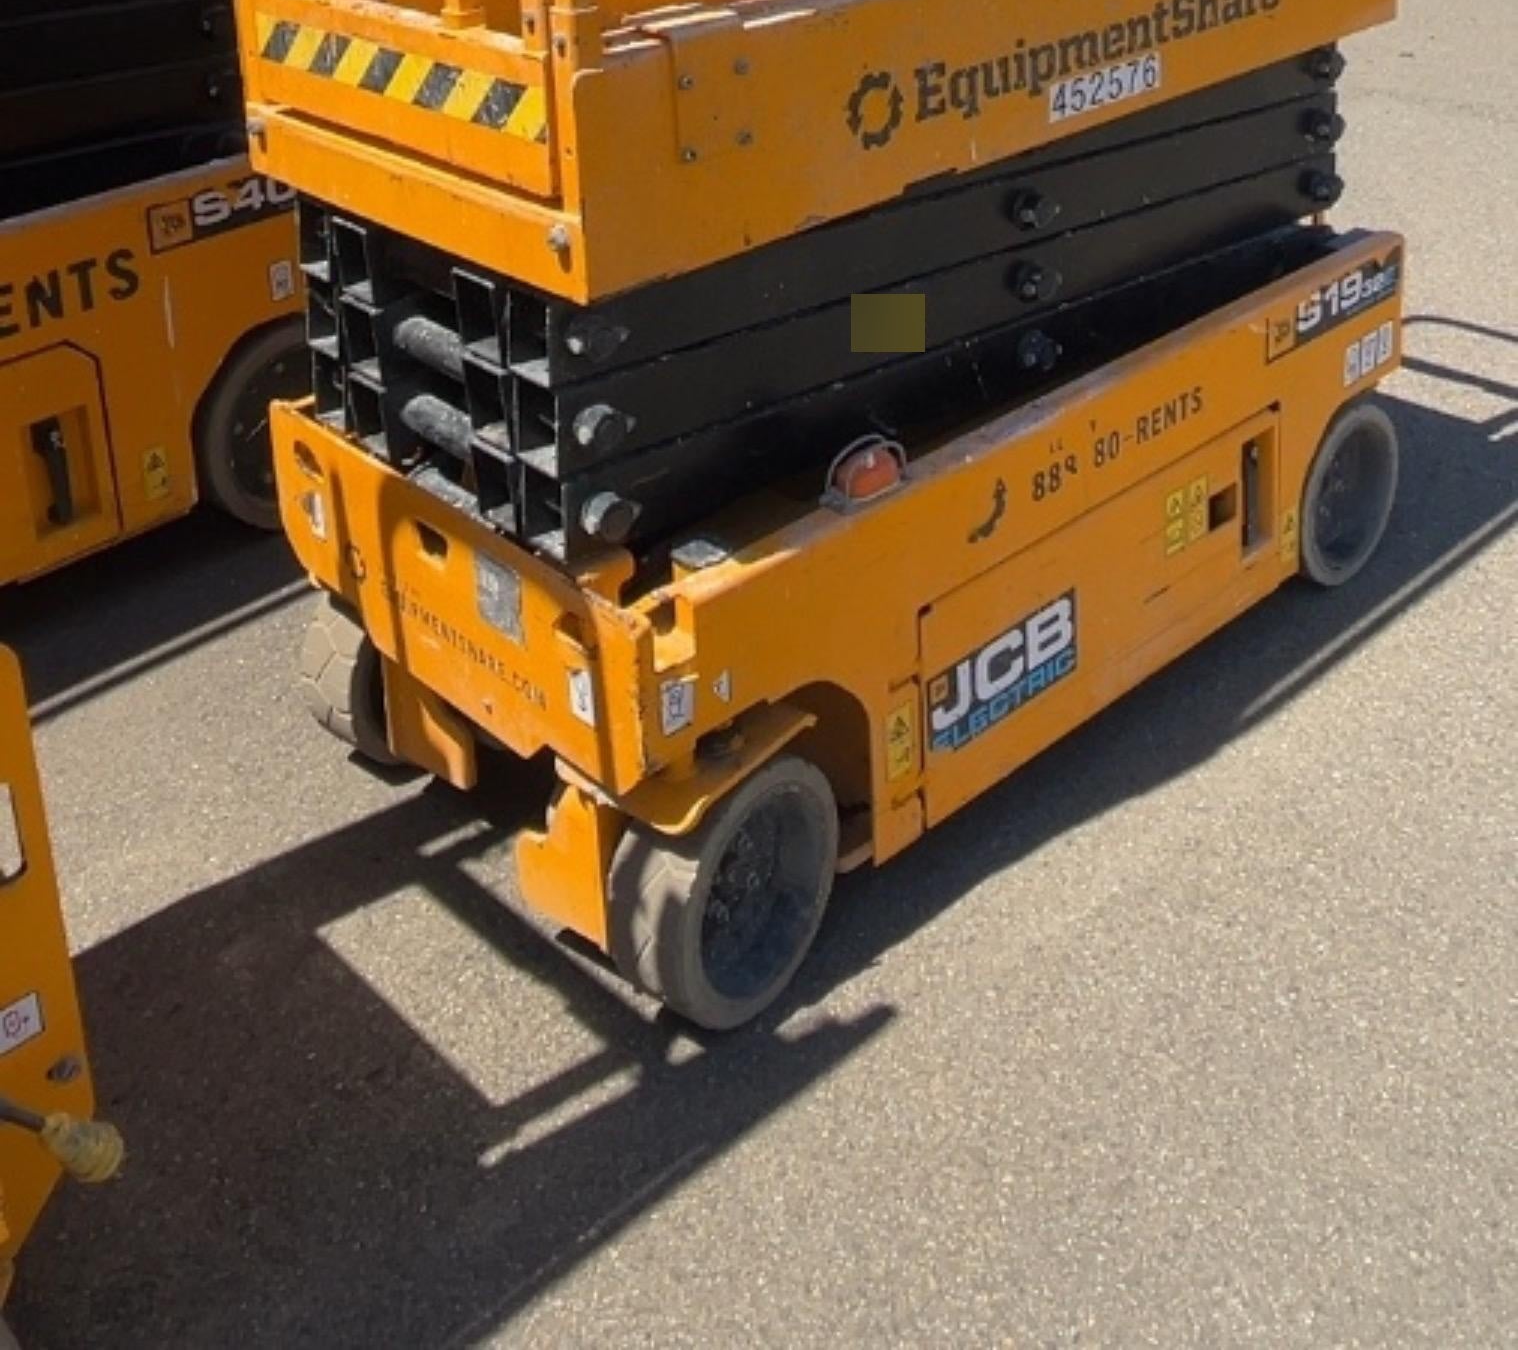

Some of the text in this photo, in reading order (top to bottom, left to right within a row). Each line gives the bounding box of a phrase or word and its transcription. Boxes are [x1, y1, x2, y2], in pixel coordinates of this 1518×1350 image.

[1051, 58, 1158, 117] 452576
[931, 649, 1077, 750] ELECTRIC
[932, 597, 1074, 730] JCB
